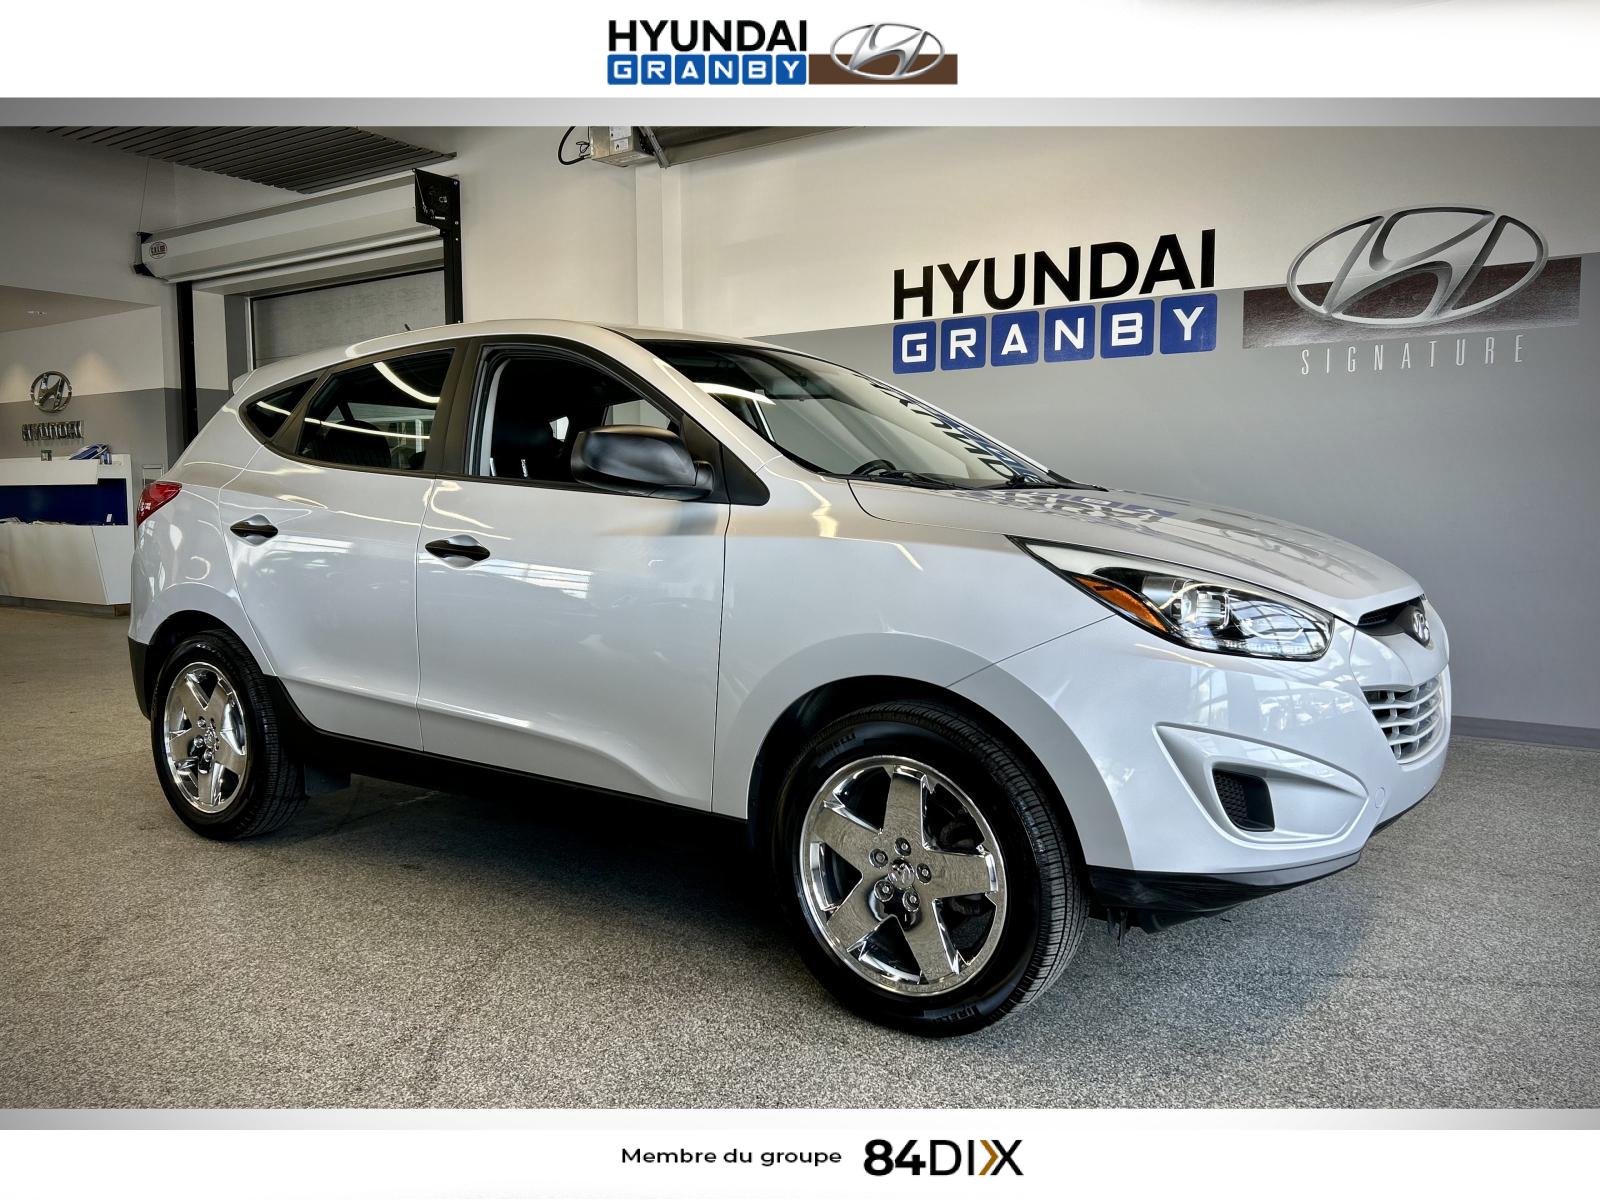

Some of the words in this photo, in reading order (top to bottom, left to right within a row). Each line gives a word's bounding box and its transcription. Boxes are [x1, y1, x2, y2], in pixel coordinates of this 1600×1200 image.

[893, 228, 1216, 320] HYUNDAI
[900, 303, 1206, 365] GRANBY
[1300, 334, 1525, 375] SIGNATURE
